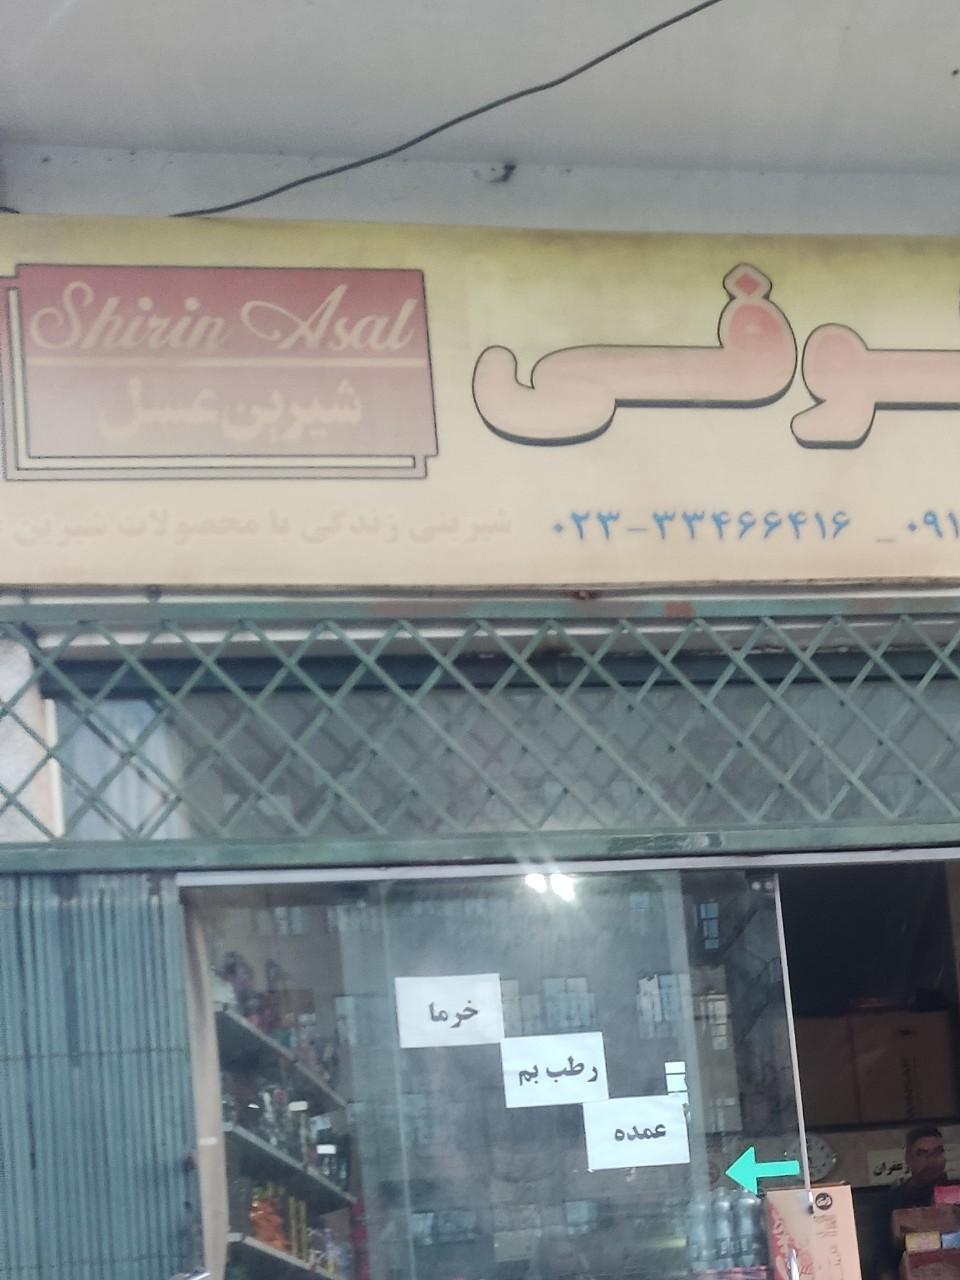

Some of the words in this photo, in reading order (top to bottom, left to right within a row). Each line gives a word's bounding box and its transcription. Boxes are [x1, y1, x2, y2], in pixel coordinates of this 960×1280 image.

[29, 280, 230, 351] Shirin
[240, 283, 419, 352] Asal
[96, 375, 219, 441] عسل
[220, 378, 362, 445] شیرین
[118, 506, 260, 546] محصولات
[428, 1000, 479, 1028] خرما
[518, 1064, 539, 1086] بم
[545, 1055, 599, 1083] رطب
[614, 1122, 667, 1142] عمده
